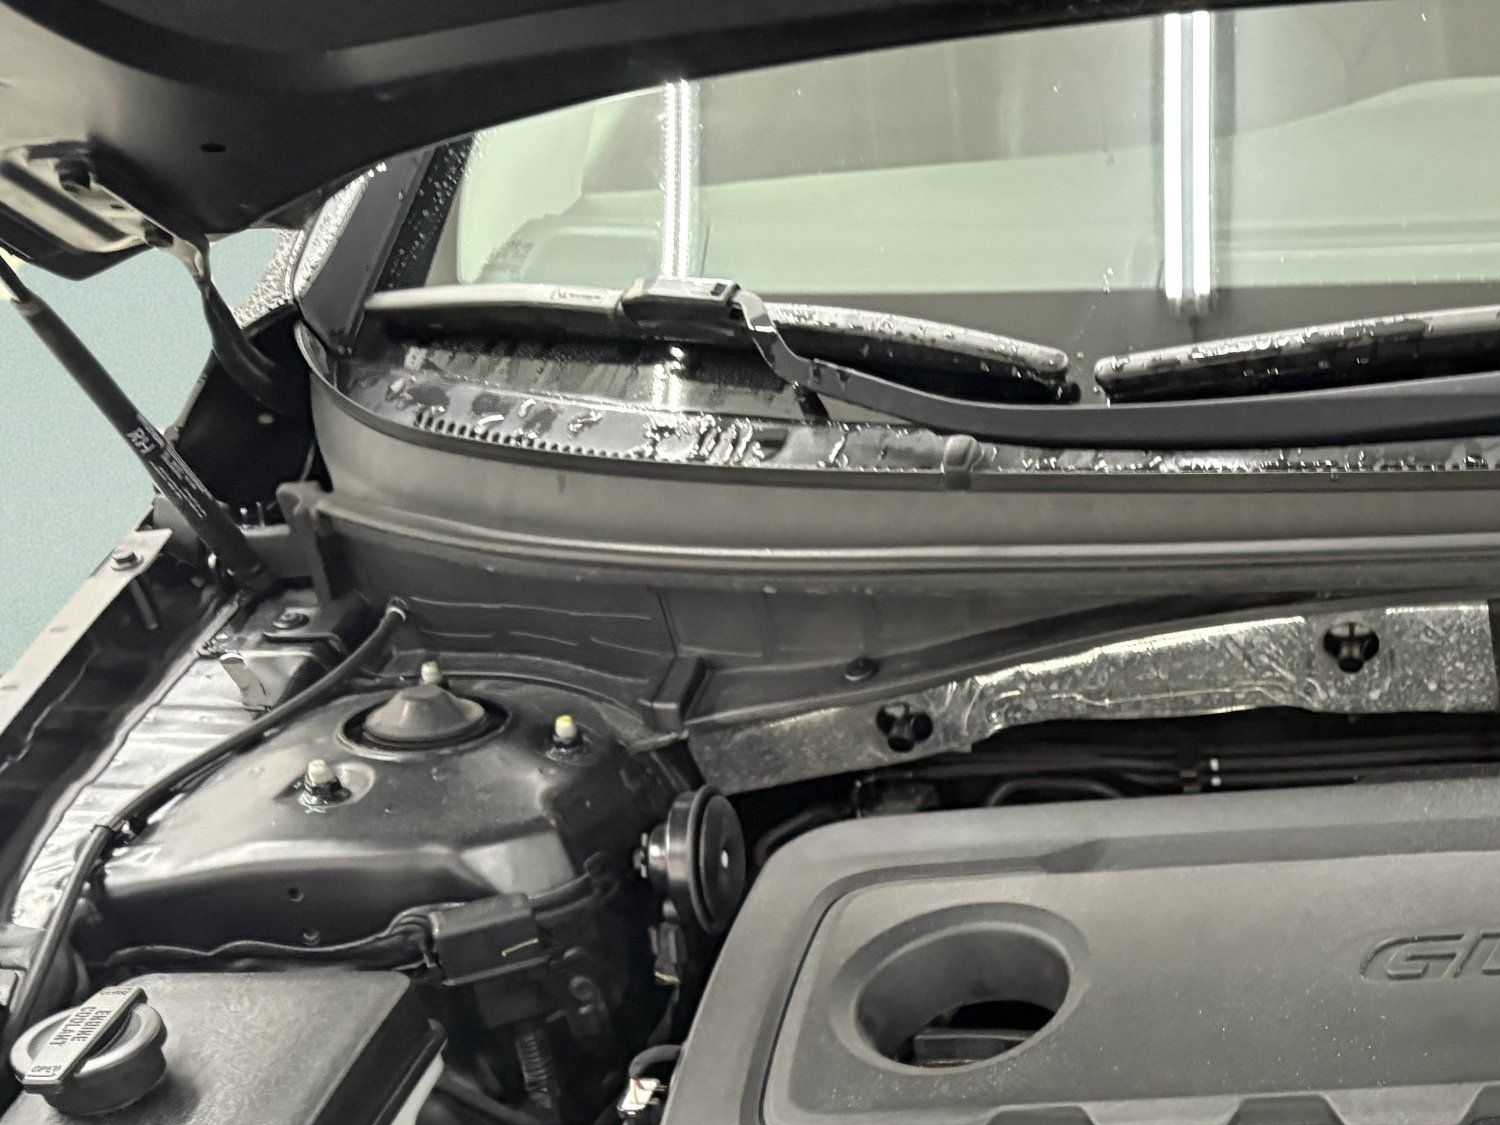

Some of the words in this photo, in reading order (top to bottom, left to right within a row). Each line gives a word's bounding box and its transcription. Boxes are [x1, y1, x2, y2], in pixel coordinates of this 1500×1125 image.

[126, 427, 157, 456] RH
[49, 1005, 98, 1047] COOLANT
[70, 1009, 113, 1043] ENGINE
